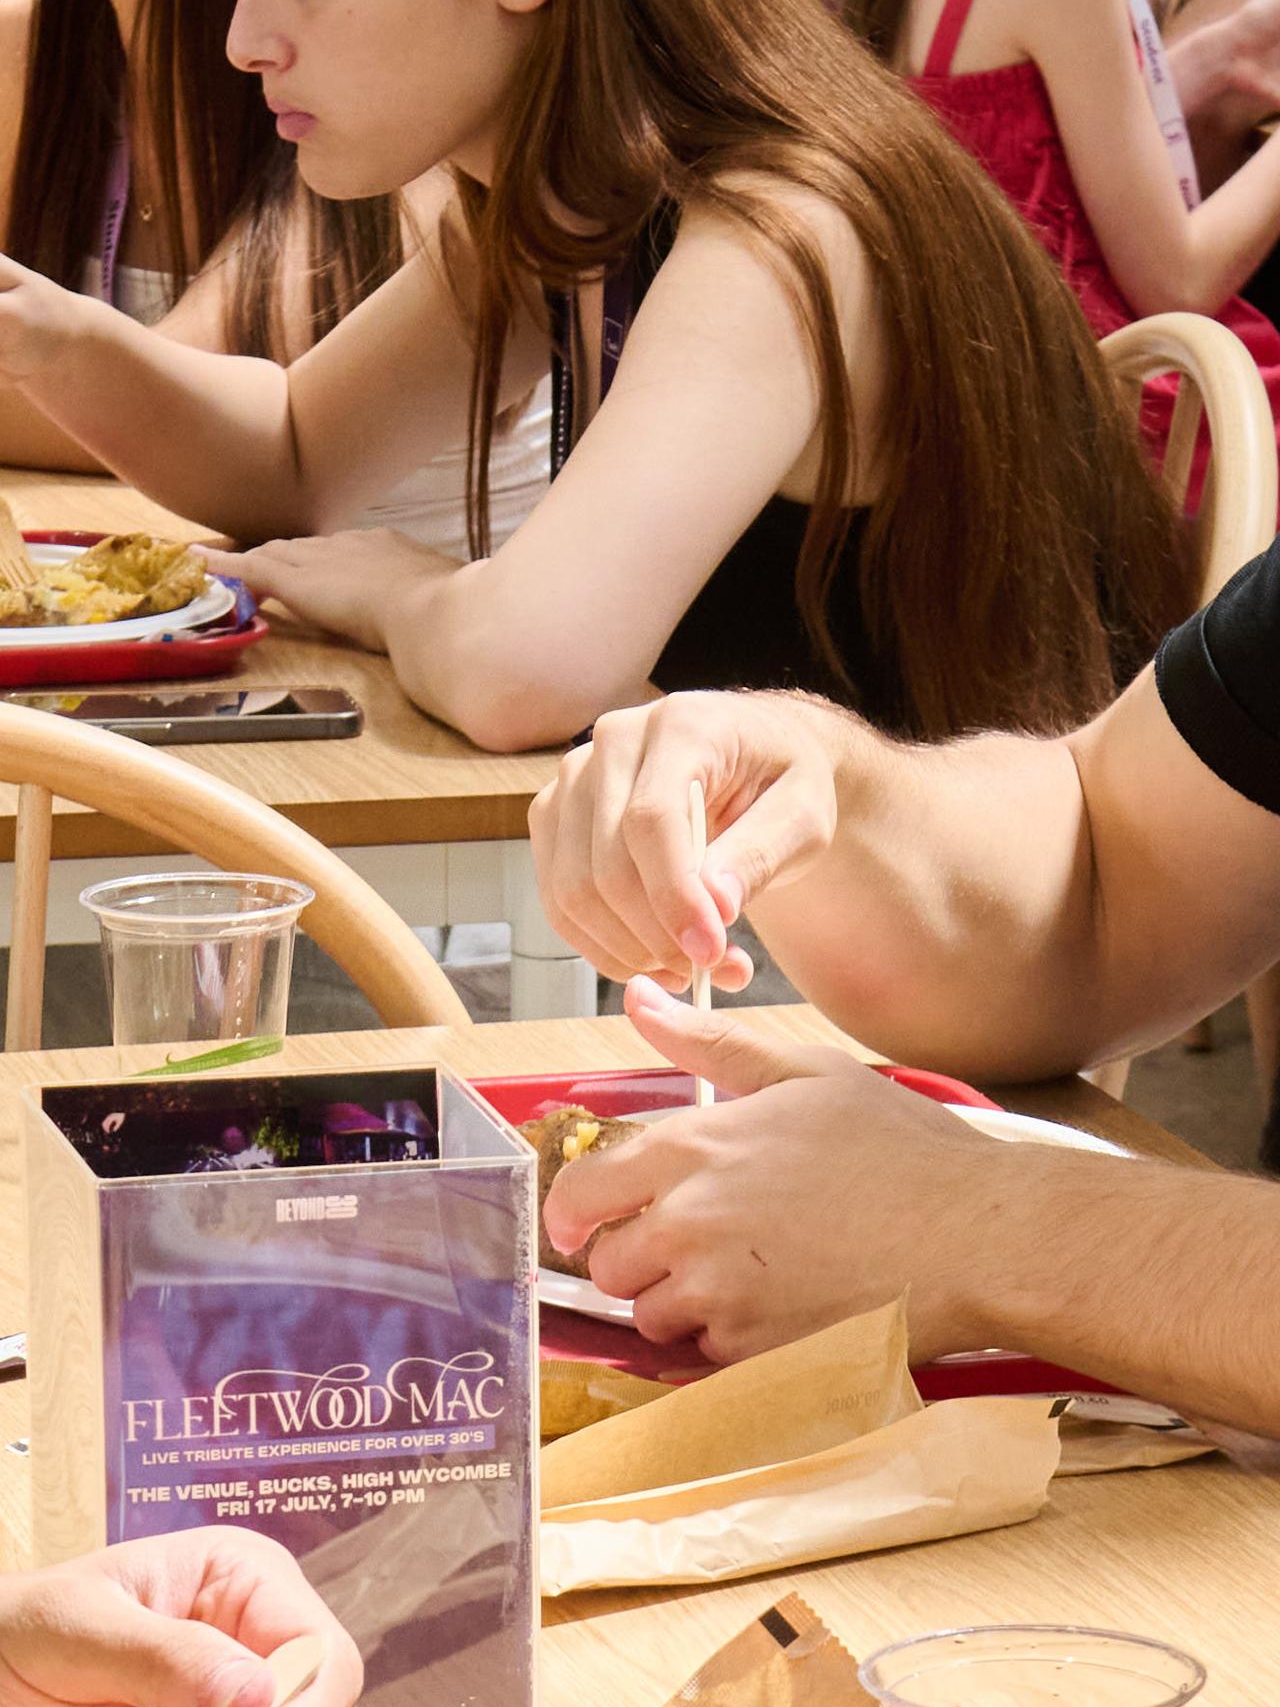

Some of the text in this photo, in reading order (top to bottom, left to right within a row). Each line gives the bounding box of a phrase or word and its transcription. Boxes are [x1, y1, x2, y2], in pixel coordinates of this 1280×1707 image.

[122, 1351, 505, 1442] FLEETWOOD MAC
[142, 1430, 486, 1465] LIVE TRIBUTE EXPERIENCE FOR OVER 30'S
[127, 1462, 512, 1503] THE VENUE, BUCKS, HIGH WYCOMBE
[216, 1500, 250, 1518] FRI
[255, 1498, 277, 1514] 17
[281, 1493, 337, 1513] JULY,
[392, 1487, 426, 1505] PM
